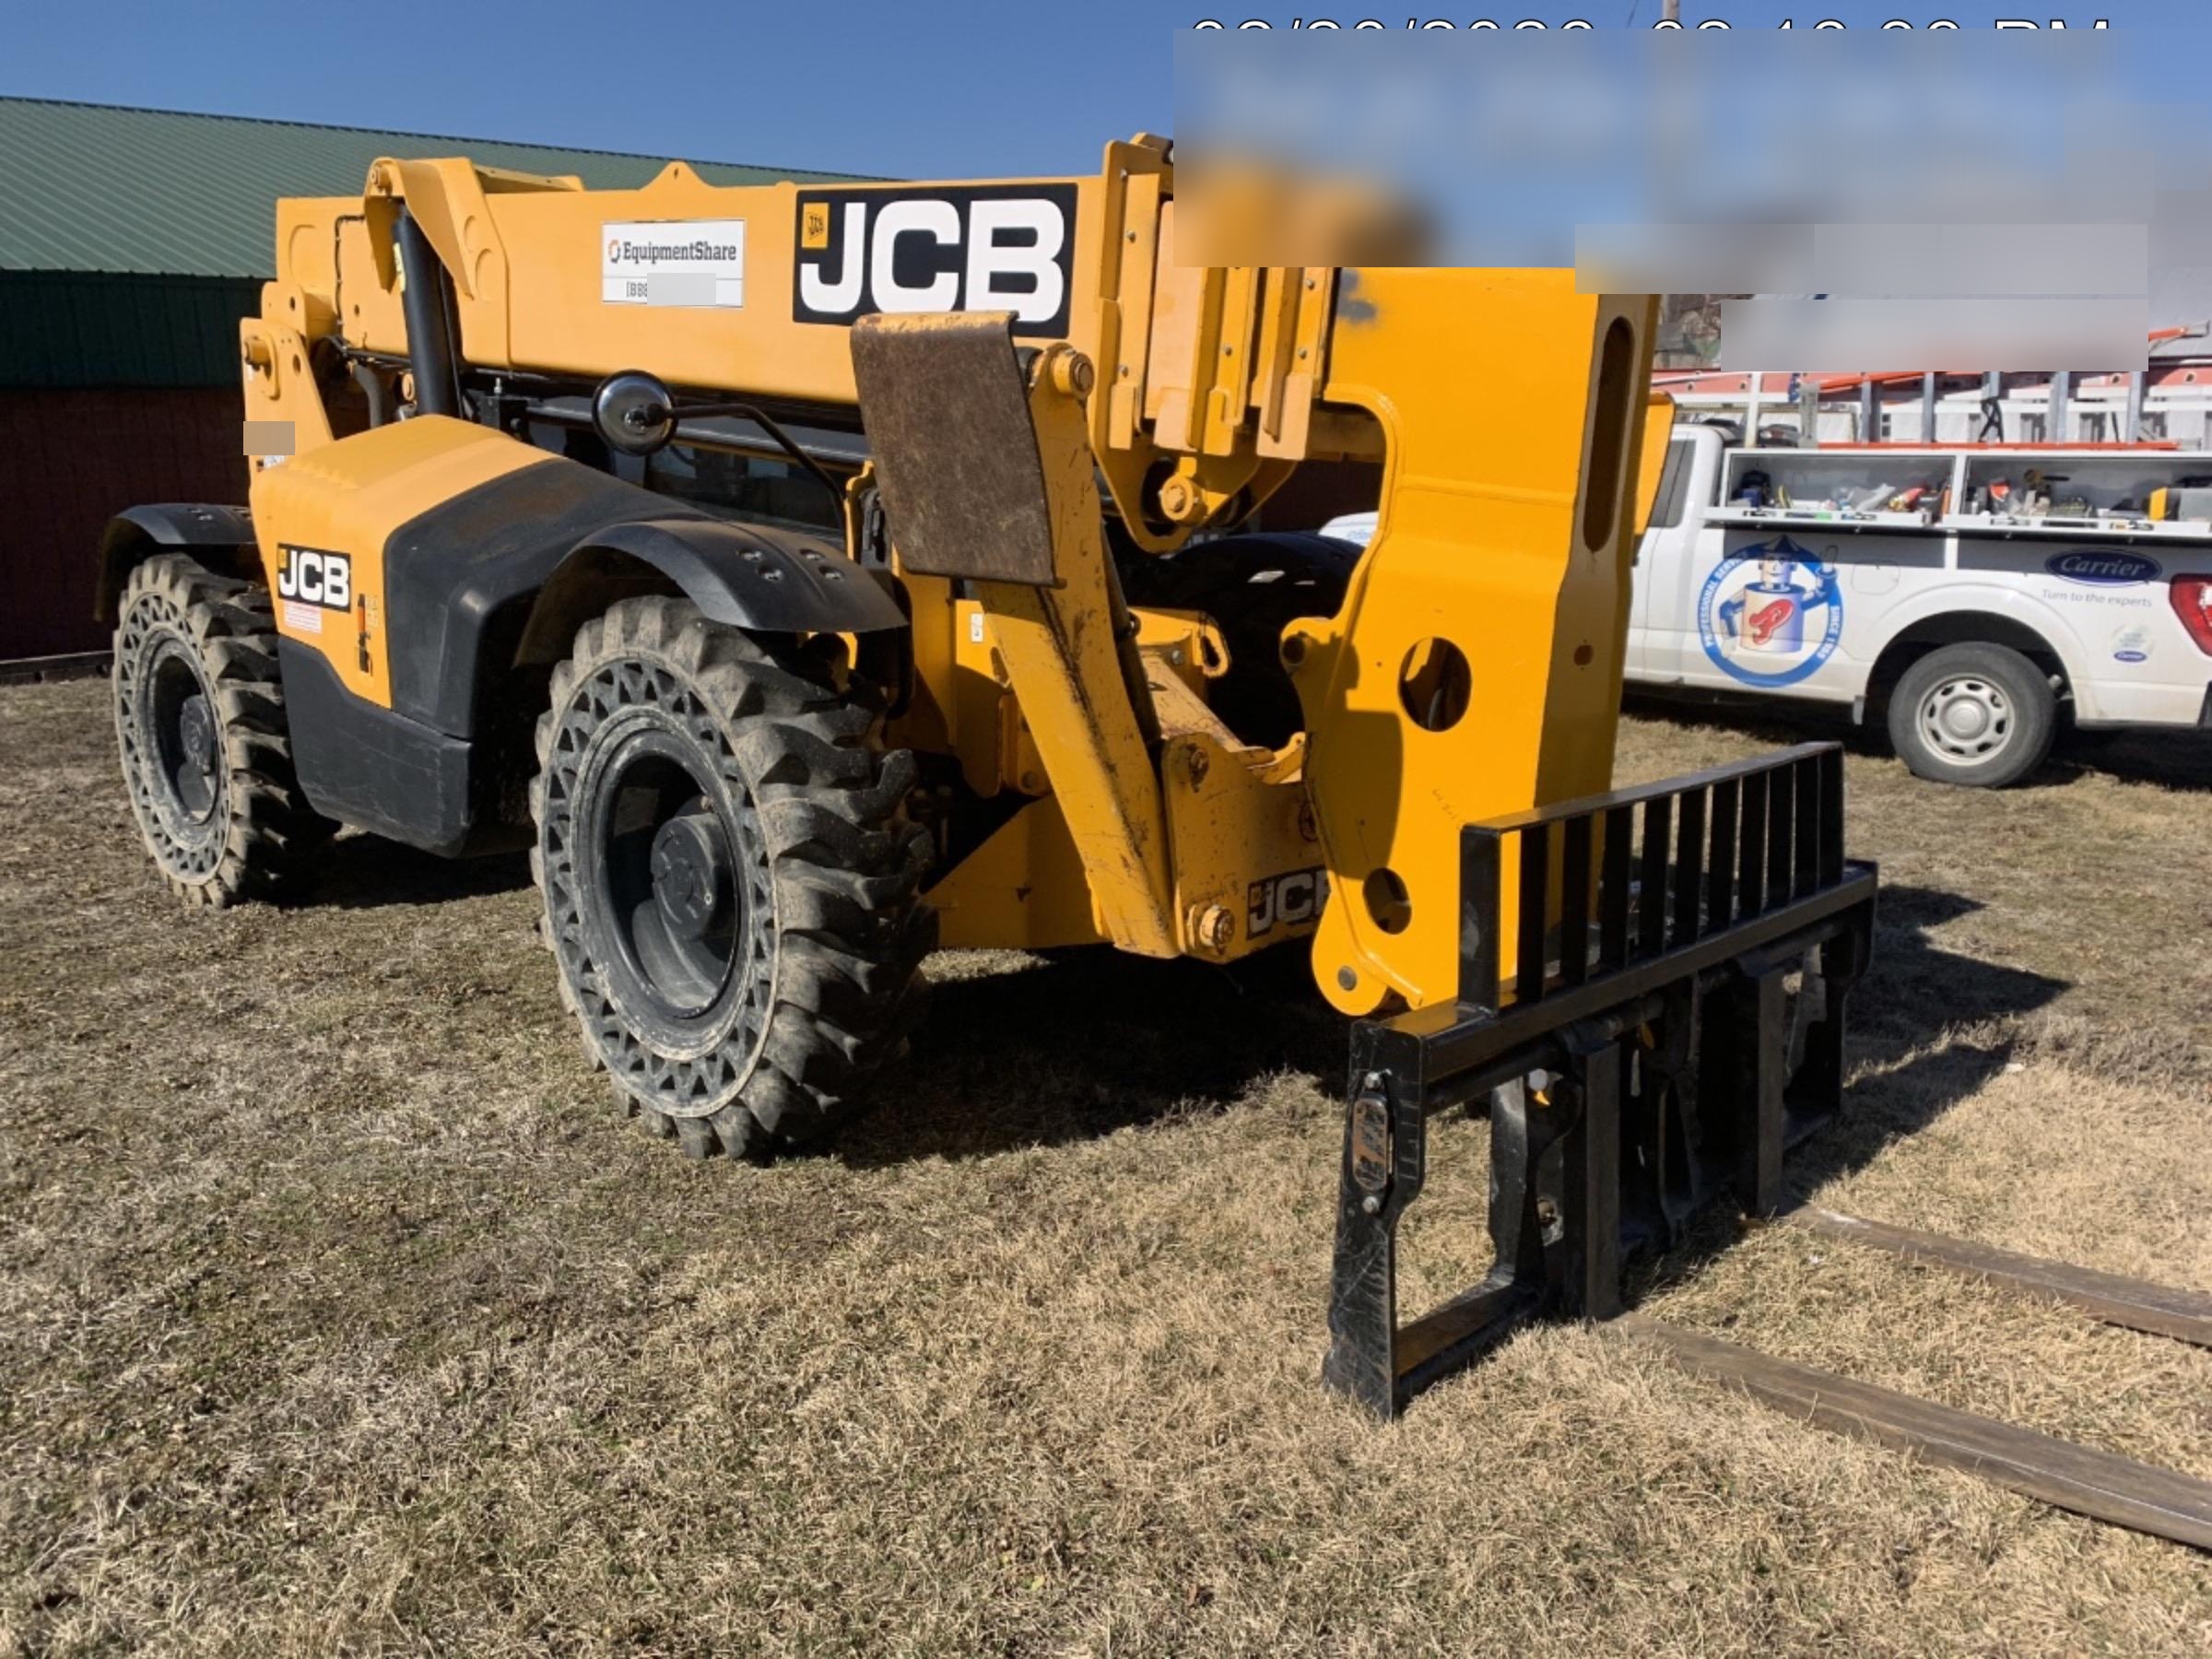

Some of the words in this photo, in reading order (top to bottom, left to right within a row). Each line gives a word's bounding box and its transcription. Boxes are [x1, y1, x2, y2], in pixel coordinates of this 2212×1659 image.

[622, 241, 736, 265] EquipmentShare
[799, 198, 1065, 323] JCB
[279, 549, 349, 607] JCB
[2060, 556, 2147, 576] Carrier
[2042, 589, 2067, 601] Turn
[2071, 591, 2084, 603] to
[2086, 593, 2105, 605] the
[2107, 596, 2153, 608] experts
